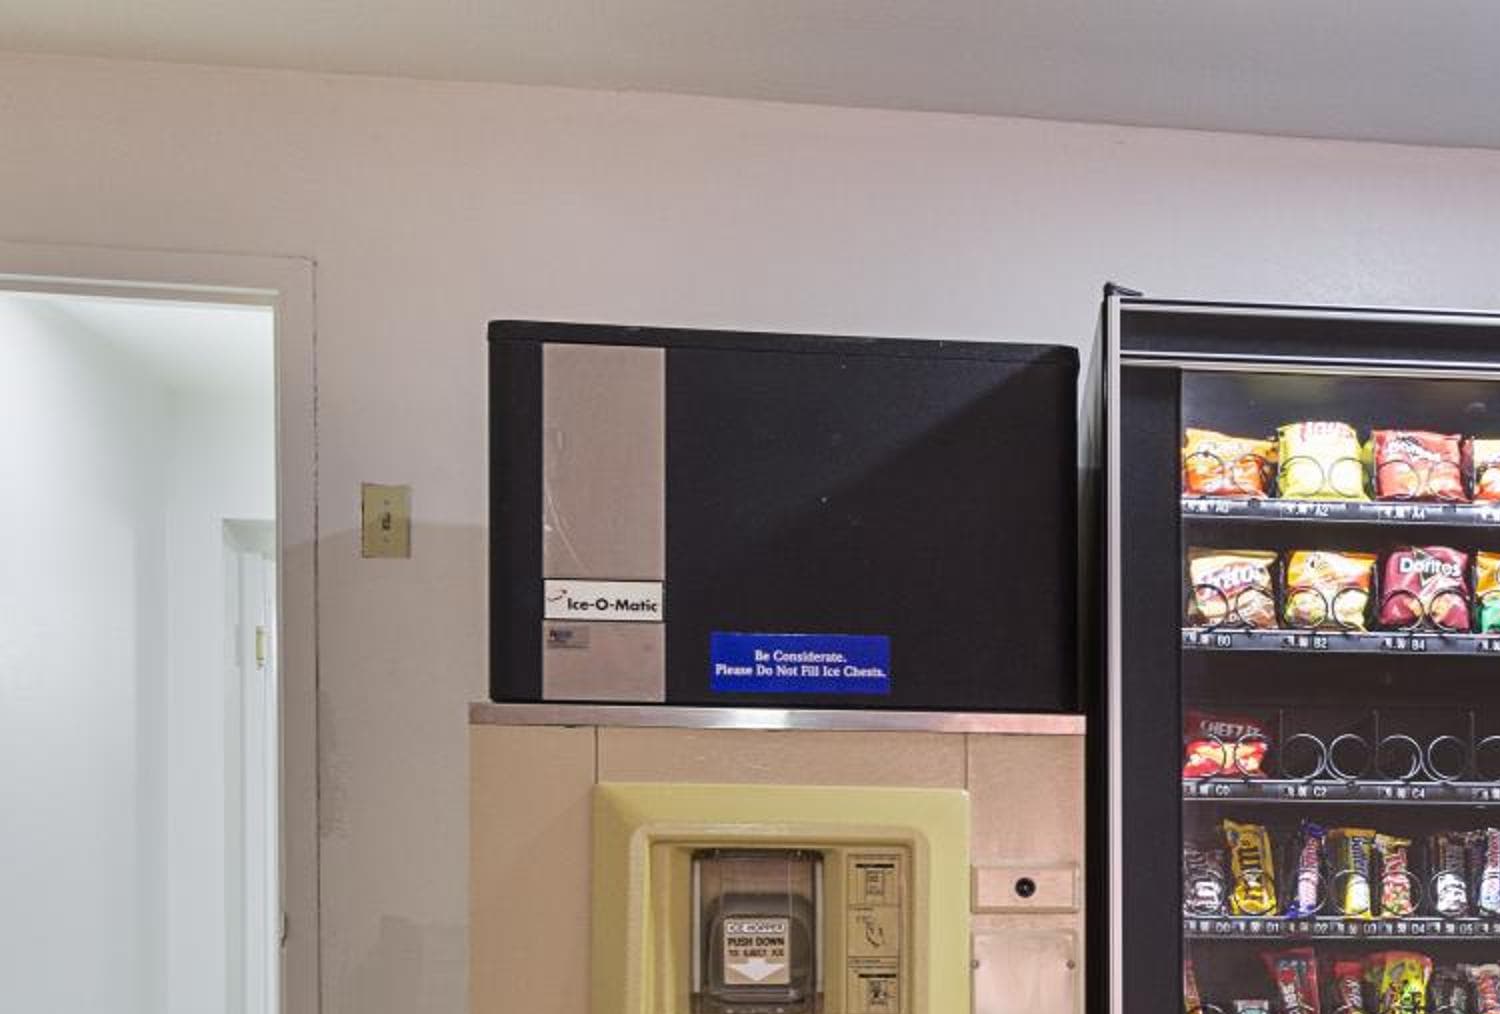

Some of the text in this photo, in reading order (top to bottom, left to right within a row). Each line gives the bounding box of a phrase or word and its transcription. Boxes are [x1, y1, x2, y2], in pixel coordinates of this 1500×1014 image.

[1400, 557, 1460, 577] Doritos
[567, 597, 657, 612] Ice-O-Matic
[755, 649, 847, 663] Be Considerate.
[715, 663, 887, 678] Please Do Not Fill Ice Chests.
[755, 936, 785, 946] DOWN
